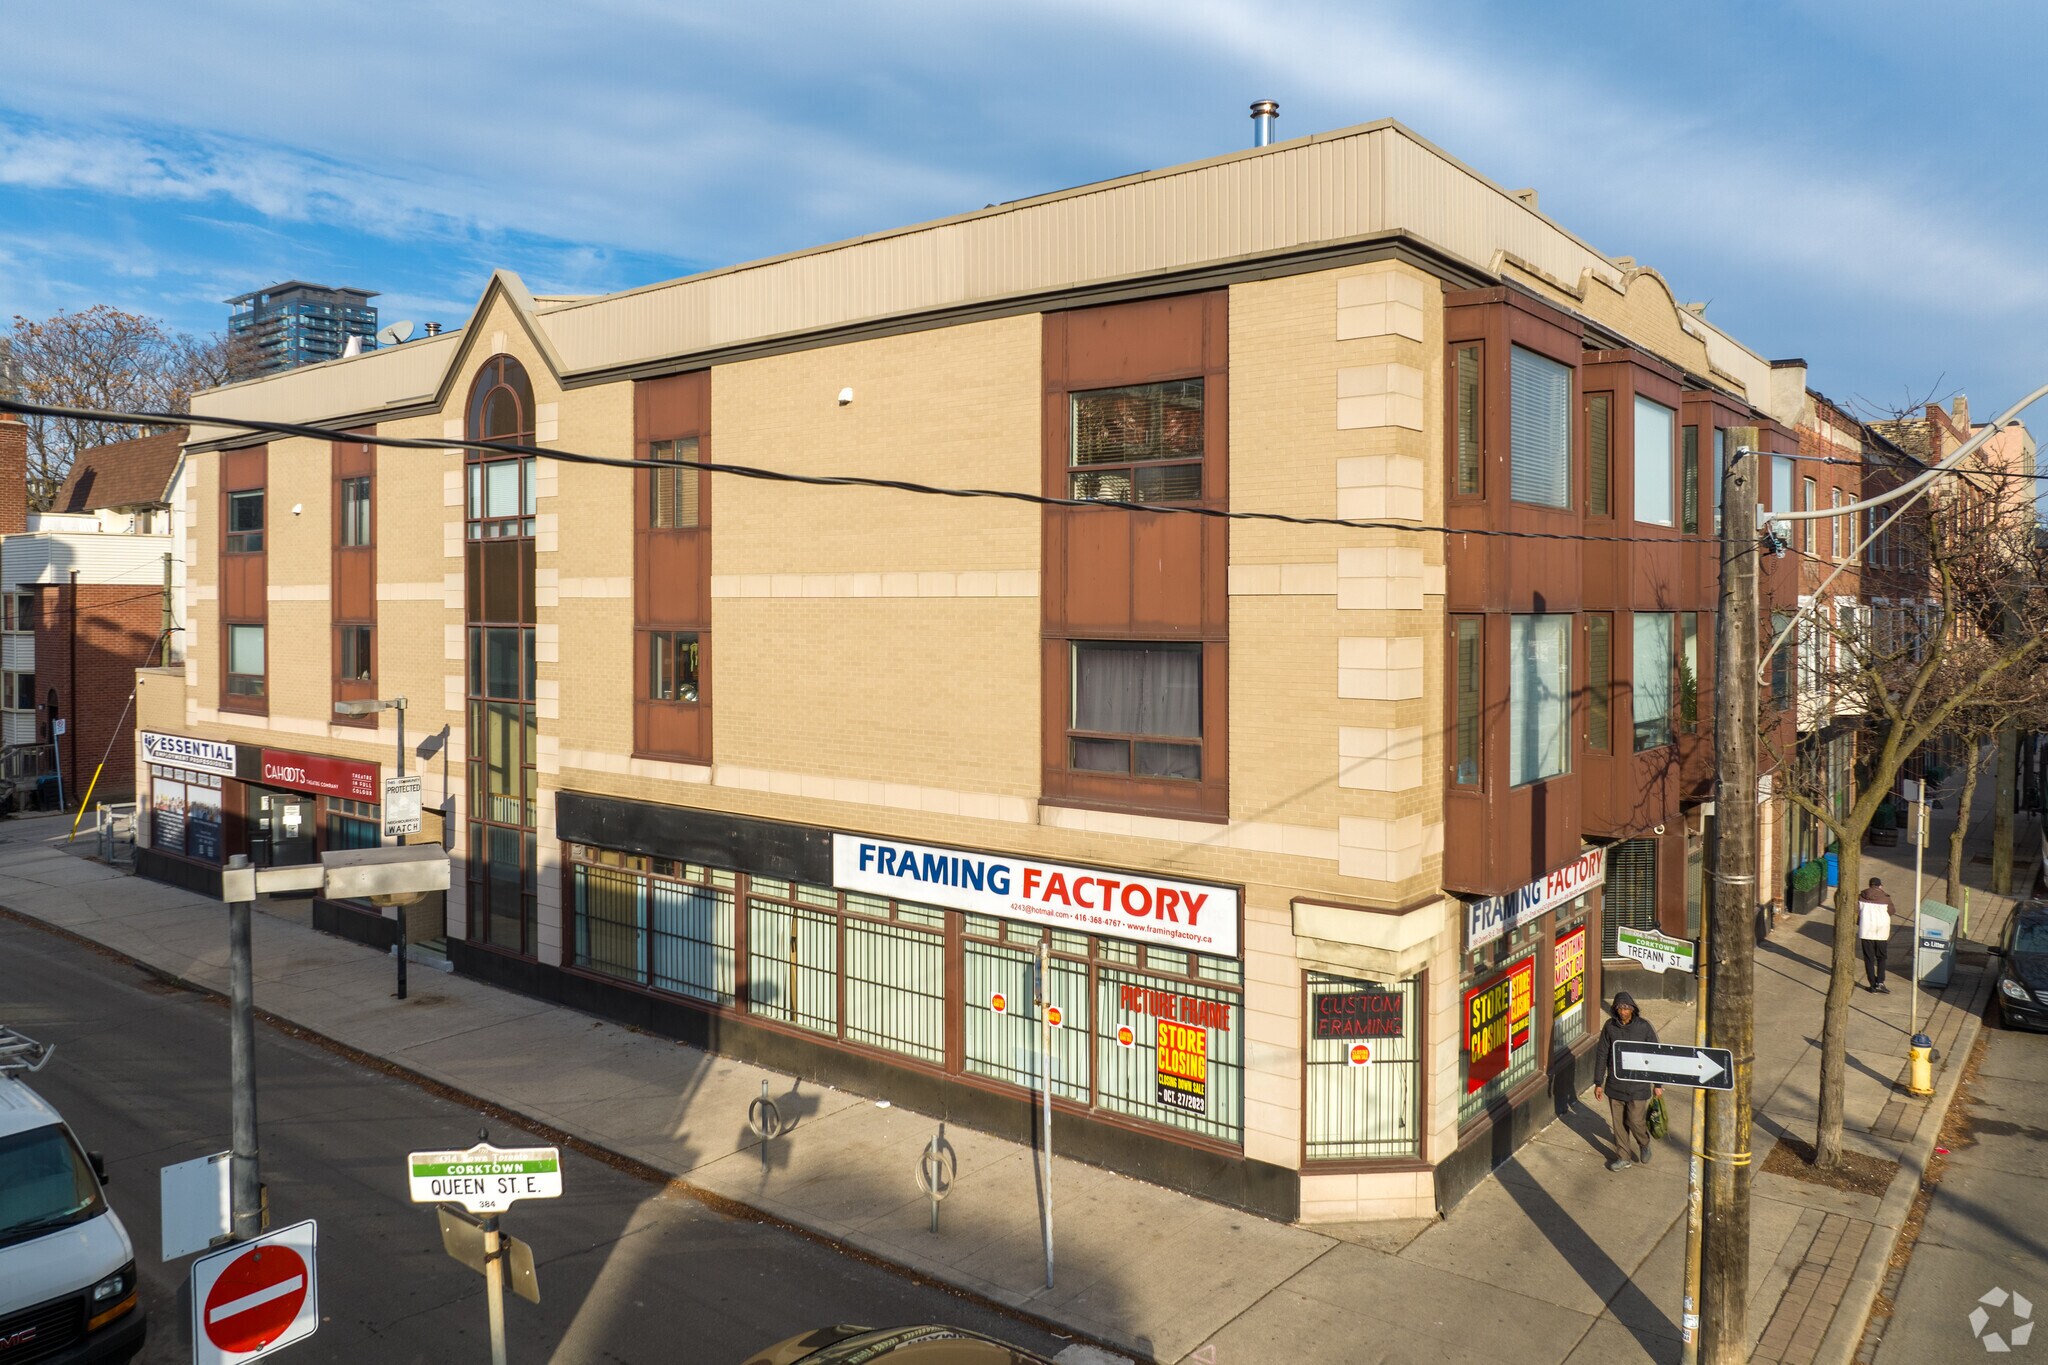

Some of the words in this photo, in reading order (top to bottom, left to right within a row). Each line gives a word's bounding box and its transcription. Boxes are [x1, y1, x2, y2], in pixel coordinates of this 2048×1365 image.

[160, 737, 233, 761] ESSENTIAL
[264, 763, 306, 784] CAHOOTS
[352, 788, 373, 796] COLOUR
[387, 783, 420, 794] PROTECTED
[388, 823, 418, 833] WATCH
[859, 843, 1010, 895] FRAMING
[1023, 868, 1209, 926] FACTORY
[1472, 880, 1541, 935] FRAMING
[1546, 849, 1603, 899] FACTORY
[1127, 922, 1212, 943] www.framingfactory.ca
[1636, 939, 1675, 952] CORKTOWN
[1930, 941, 1945, 949] Litter
[1628, 945, 1664, 963] TREFANN
[1670, 955, 1682, 968] ST.
[1555, 959, 1573, 986] MUST
[1120, 985, 1177, 1021] PICTURE
[1181, 996, 1231, 1032] FRAME
[1320, 995, 1401, 1015] CUSTOM
[1472, 981, 1509, 1028] STORE
[1318, 1017, 1402, 1036] FRAMING
[1158, 1023, 1205, 1055] STORE
[1471, 1015, 1508, 1063] CLOSING
[1158, 1047, 1205, 1079] CLOSING
[1158, 1073, 1178, 1088] CLOSING
[1178, 1078, 1193, 1092] DOWN
[1193, 1082, 1205, 1095] SALE
[1163, 1089, 1175, 1103] OCT.
[1177, 1092, 1205, 1112] 27/2023
[439, 1154, 457, 1163] Old
[492, 1153, 529, 1164] Toronto
[447, 1163, 524, 1175] CORKTOWN
[431, 1178, 485, 1196] QUEEN
[498, 1177, 520, 1194] ST.
[527, 1177, 541, 1193] E.
[479, 1200, 496, 1208] 384
[0, 1326, 36, 1350] MC
